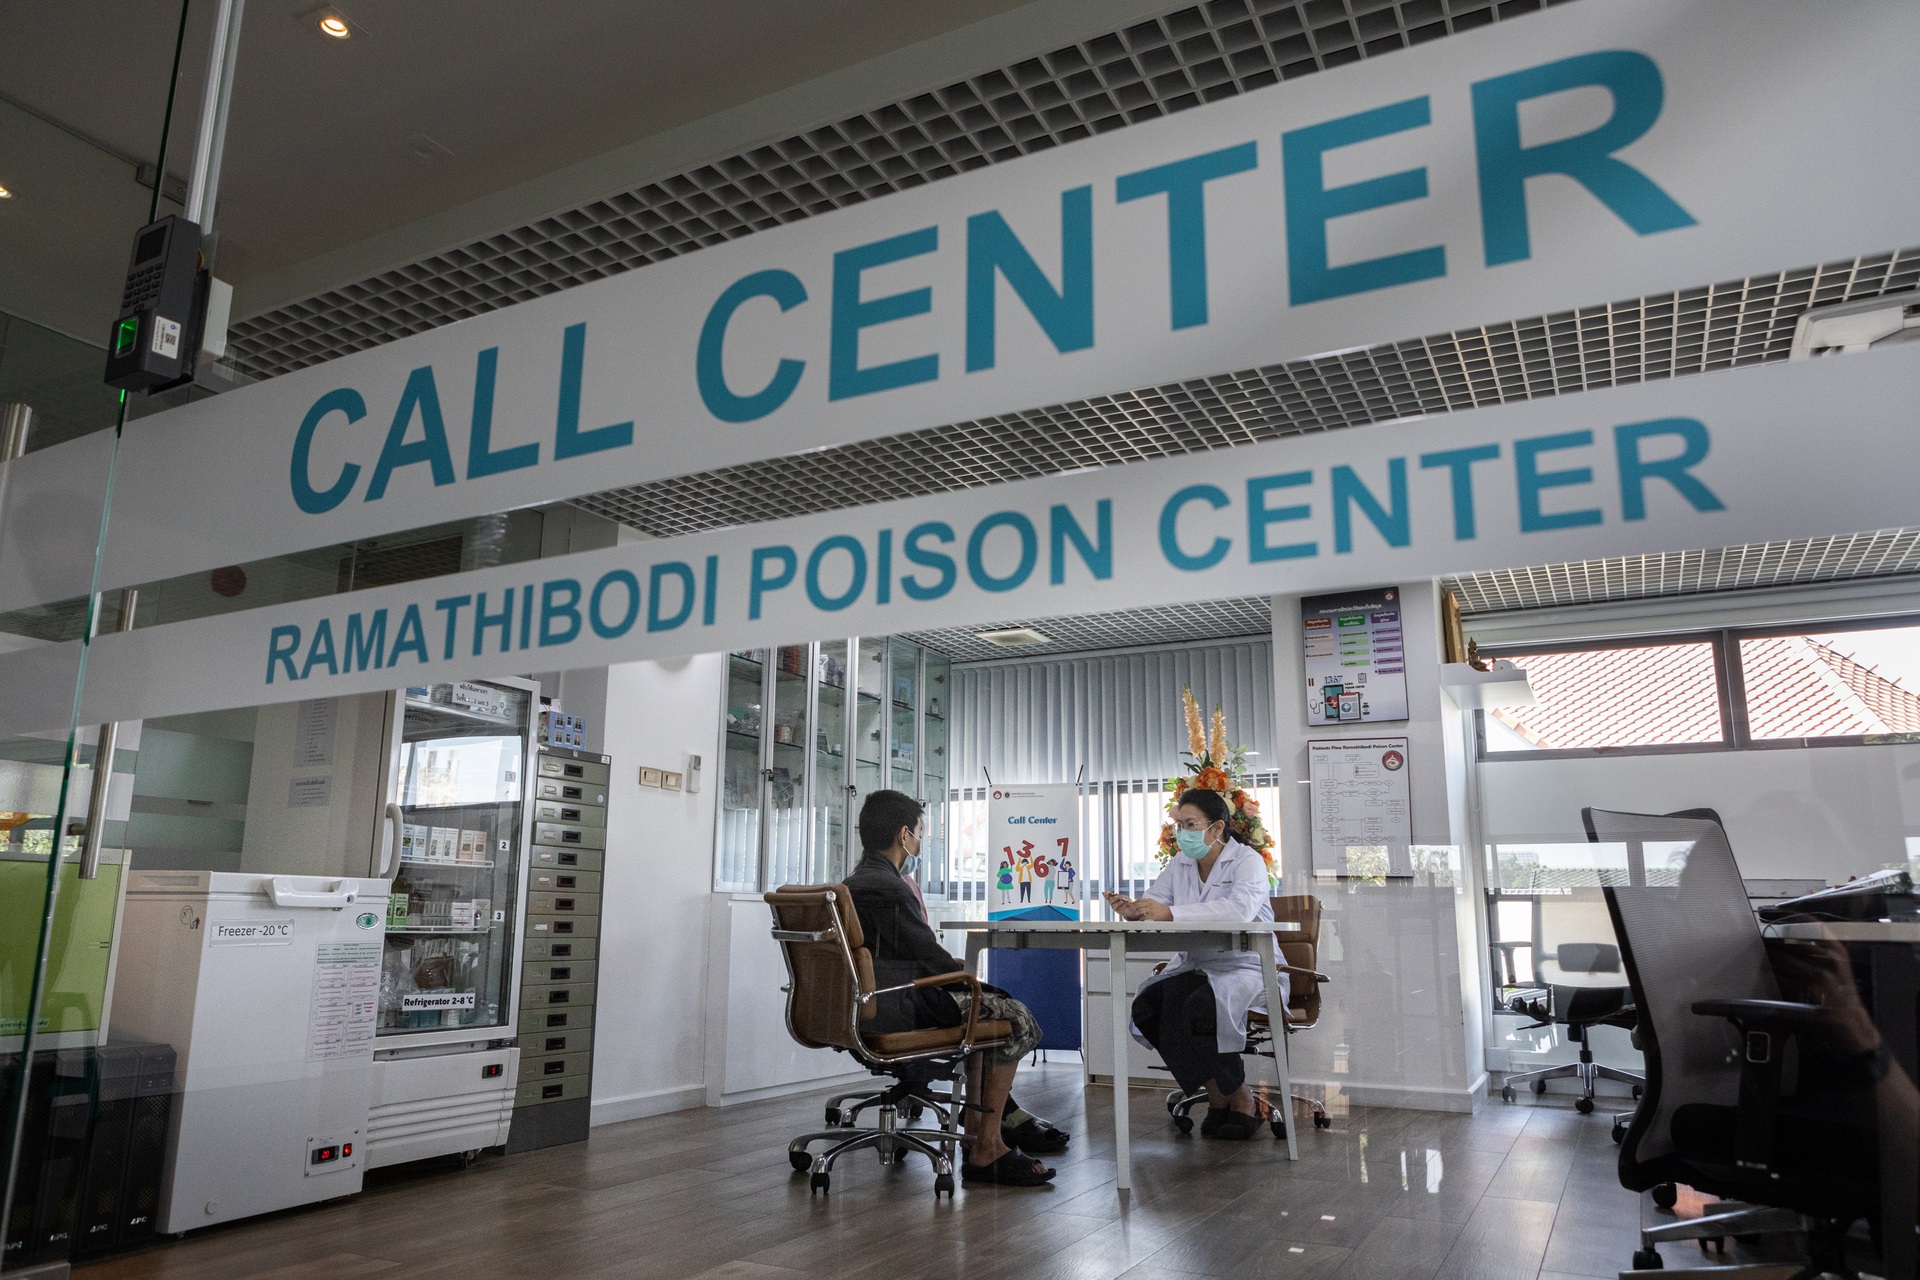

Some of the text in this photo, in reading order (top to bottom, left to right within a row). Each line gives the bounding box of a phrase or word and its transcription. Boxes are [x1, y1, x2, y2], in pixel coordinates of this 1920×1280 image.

[289, 48, 1699, 515] CALL CENTER
[265, 416, 1726, 684] RAMATHIBODI POISON CENTER
[1008, 815, 1058, 824] Call Center
[502, 841, 507, 849] 2
[496, 912, 501, 920] 3
[218, 924, 289, 937] Freezer -20 °C
[404, 996, 474, 1008] Refrigerator 2-8 °C
[130, 1216, 147, 1225] APC
